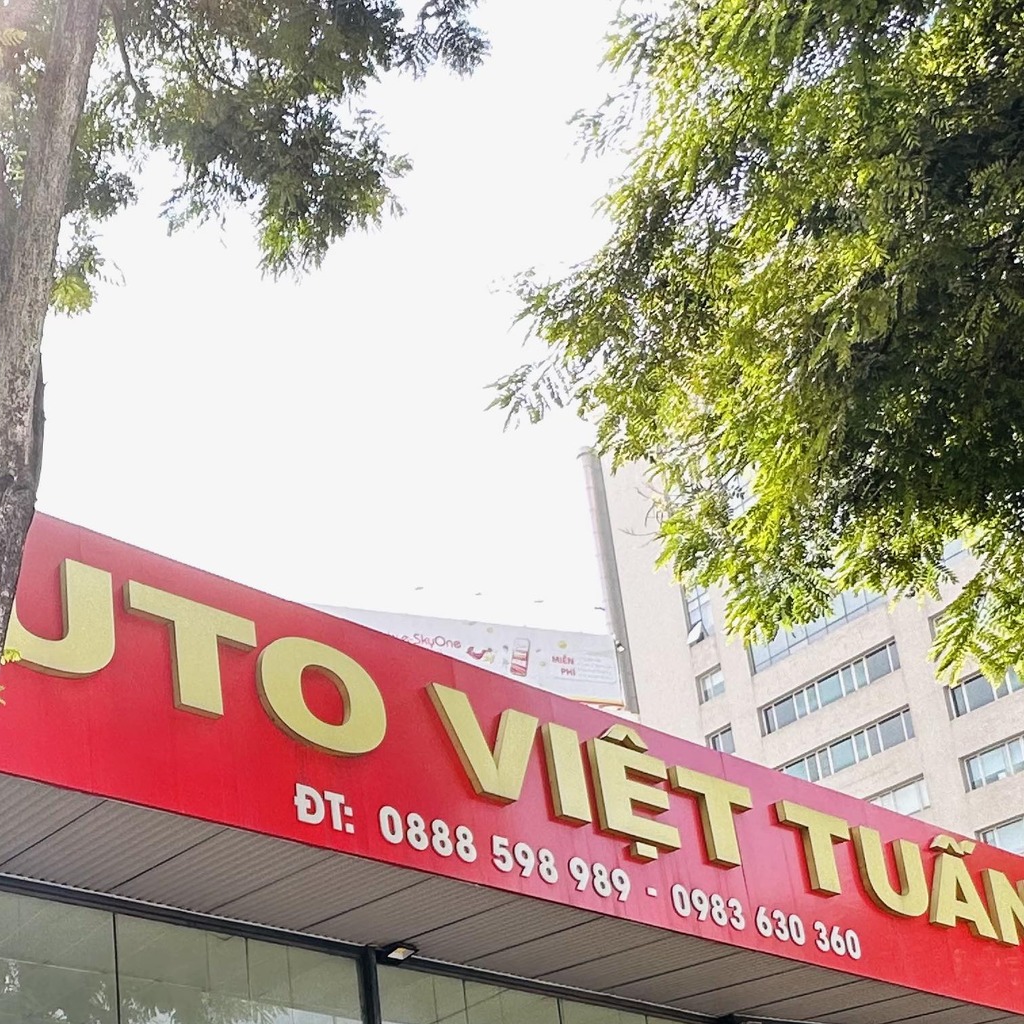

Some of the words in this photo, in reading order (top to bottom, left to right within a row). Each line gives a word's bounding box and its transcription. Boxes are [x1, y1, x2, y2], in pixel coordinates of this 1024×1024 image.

[427, 680, 753, 868] VIỆT
[294, 782, 356, 835] ĐT:
[379, 804, 478, 864] 0888
[491, 835, 559, 885] 598
[568, 855, 632, 903] 989
[672, 883, 747, 932] 0983
[755, 905, 806, 946] 630
[814, 919, 862, 961] 360
